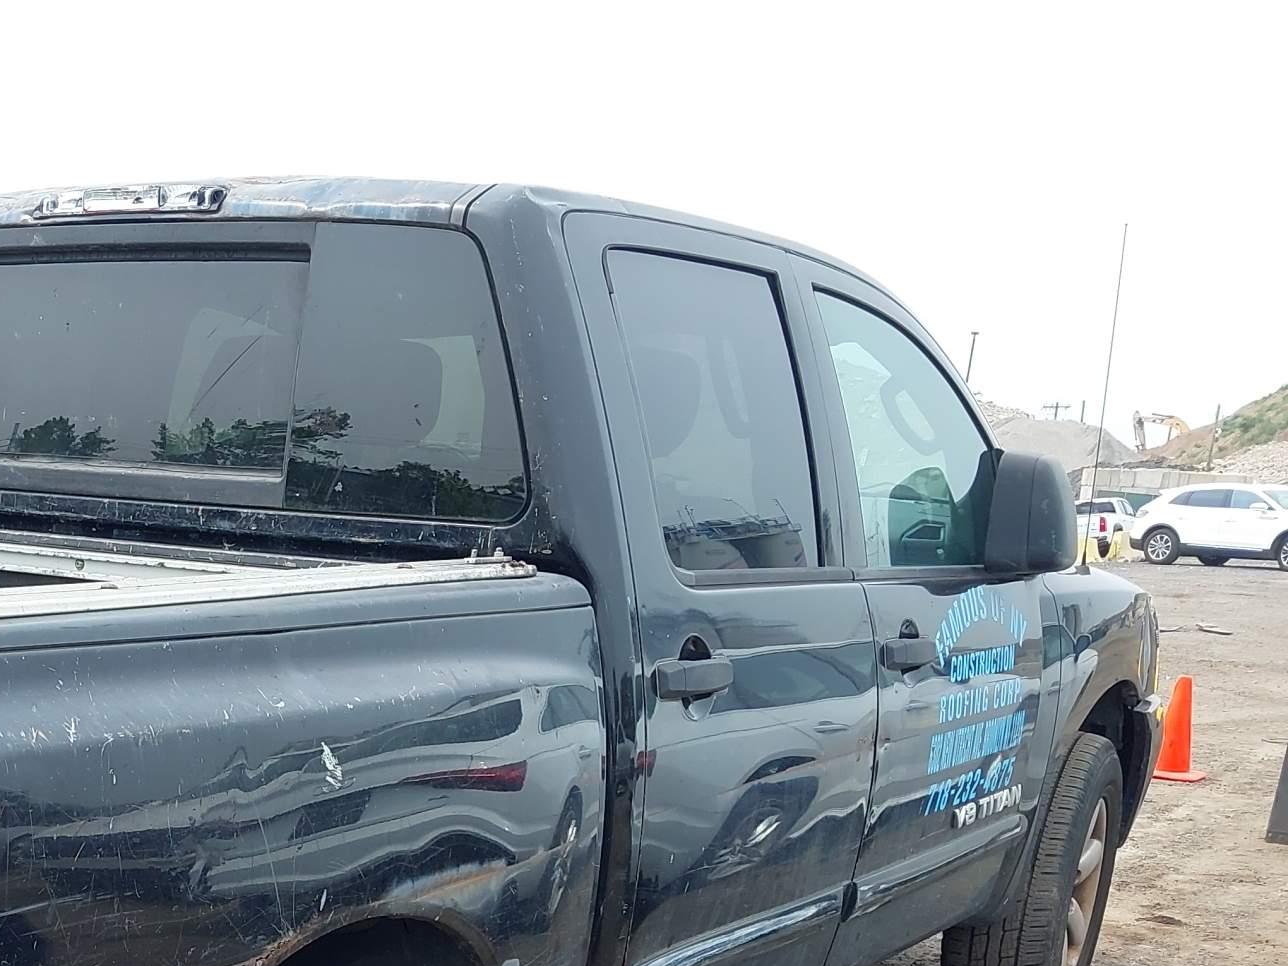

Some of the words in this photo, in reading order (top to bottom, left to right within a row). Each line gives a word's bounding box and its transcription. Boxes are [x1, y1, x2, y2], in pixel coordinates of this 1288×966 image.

[935, 585, 987, 669] FAMOUS
[1010, 602, 1027, 648] NY
[950, 644, 1016, 683] CONSTRUCTION
[939, 686, 989, 724] ROOFING
[993, 678, 1023, 709] CORP.
[953, 802, 977, 829] V8
[979, 784, 1022, 819] TITAN
